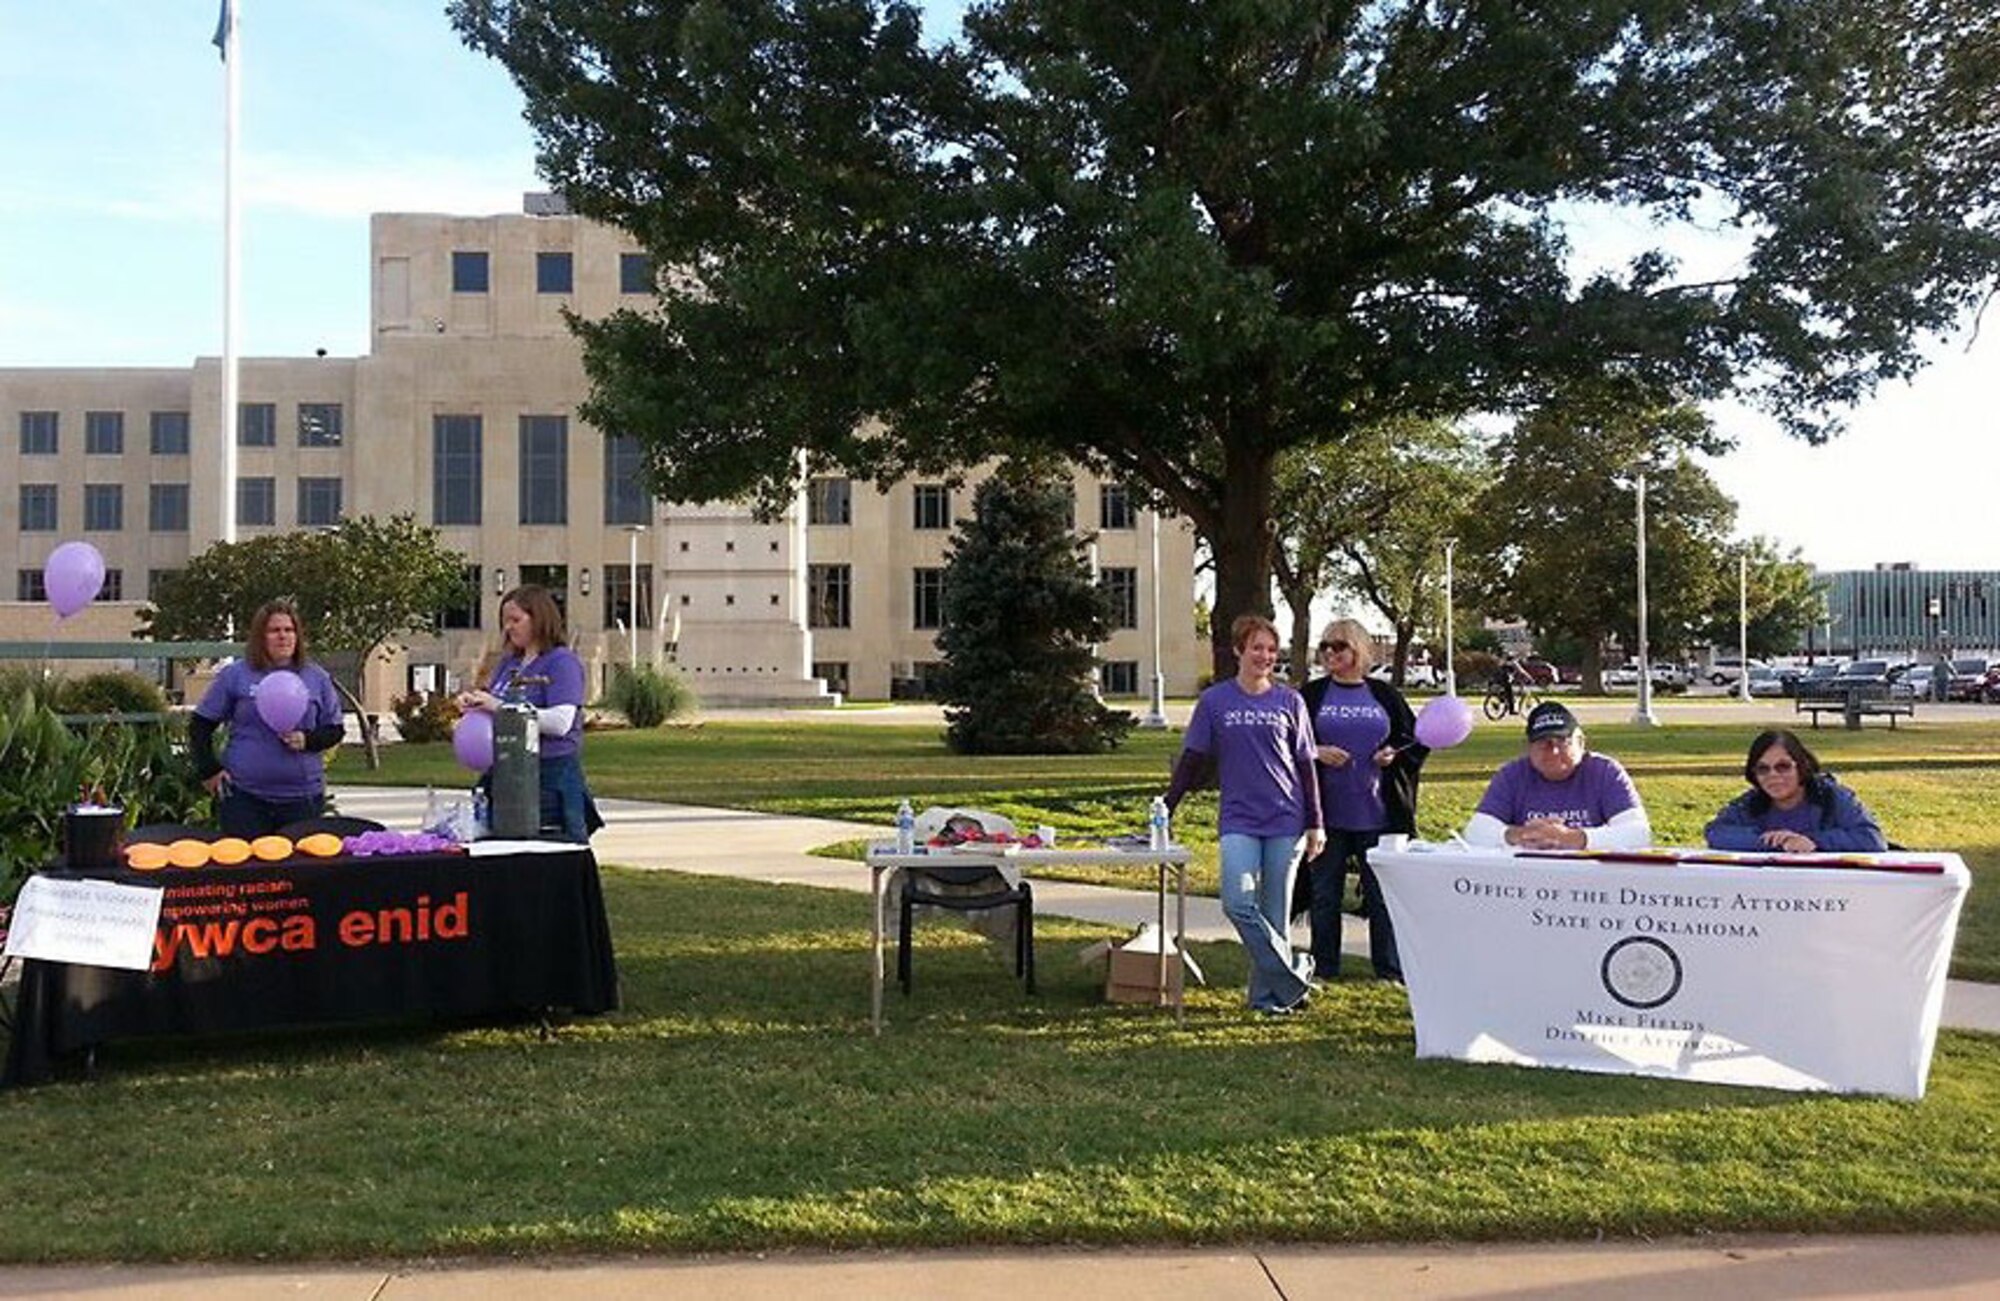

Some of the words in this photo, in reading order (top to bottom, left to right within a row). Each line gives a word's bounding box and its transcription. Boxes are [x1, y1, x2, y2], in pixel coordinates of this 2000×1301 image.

[240, 881, 293, 895] racism
[1454, 877, 1526, 899] OFFICE
[1536, 888, 1560, 901] OF
[1572, 889, 1609, 904] THE
[1620, 887, 1722, 909] DISTRICT
[1731, 893, 1849, 912] ATTORNEY
[252, 898, 309, 912] women
[151, 914, 316, 973] ywca
[338, 891, 469, 947] enid
[1532, 908, 1590, 929] STATE
[1600, 917, 1625, 930] OF
[1635, 915, 1760, 938] OKLAHOMA
[1575, 1009, 1625, 1026] MIKE
[1637, 1013, 1705, 1032] FIELDS
